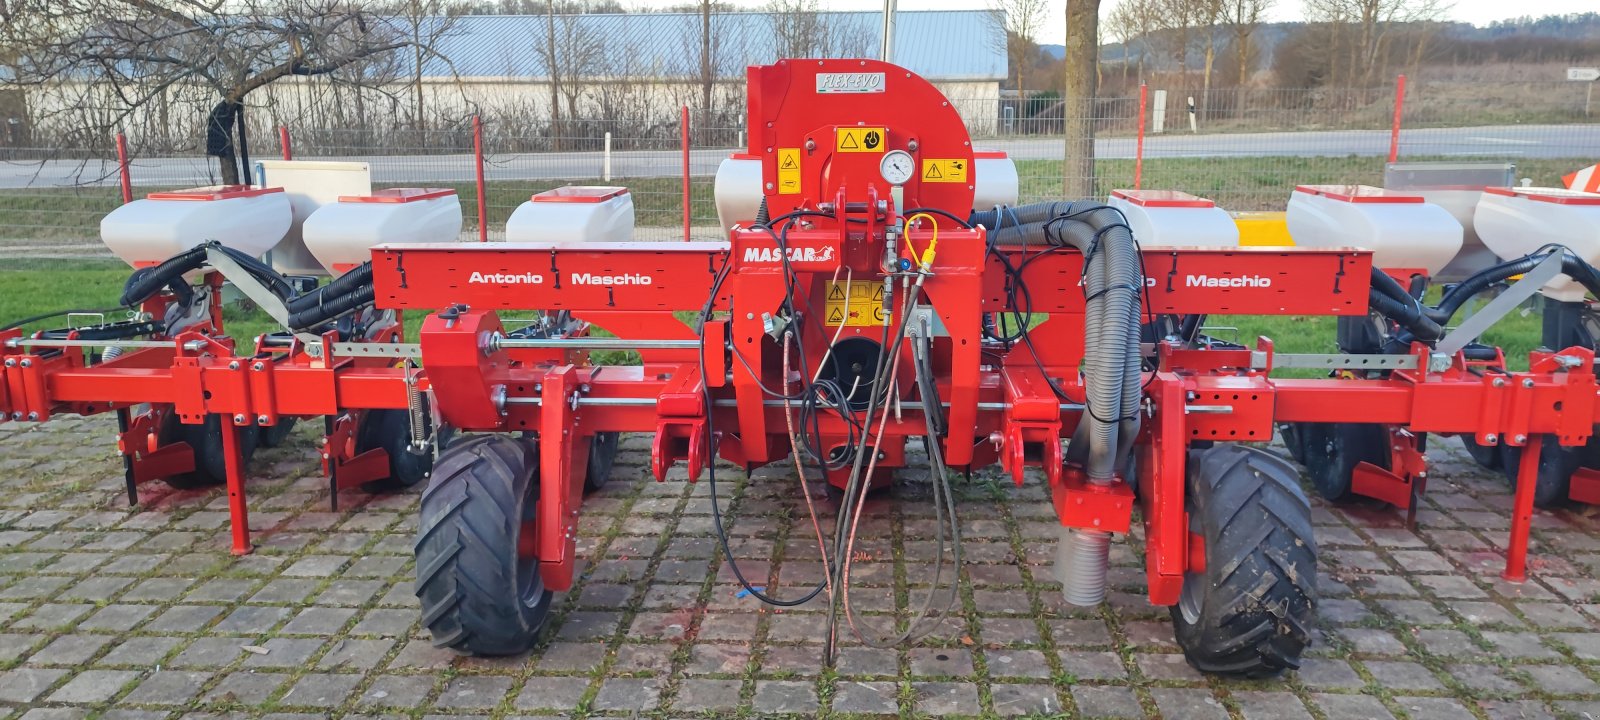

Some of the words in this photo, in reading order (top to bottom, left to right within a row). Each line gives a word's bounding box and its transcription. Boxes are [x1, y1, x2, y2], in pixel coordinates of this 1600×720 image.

[822, 74, 881, 88] FLEX-EVO
[468, 271, 543, 284] Antonio
[571, 273, 652, 285] Maschio
[1186, 274, 1271, 287] Maschio
